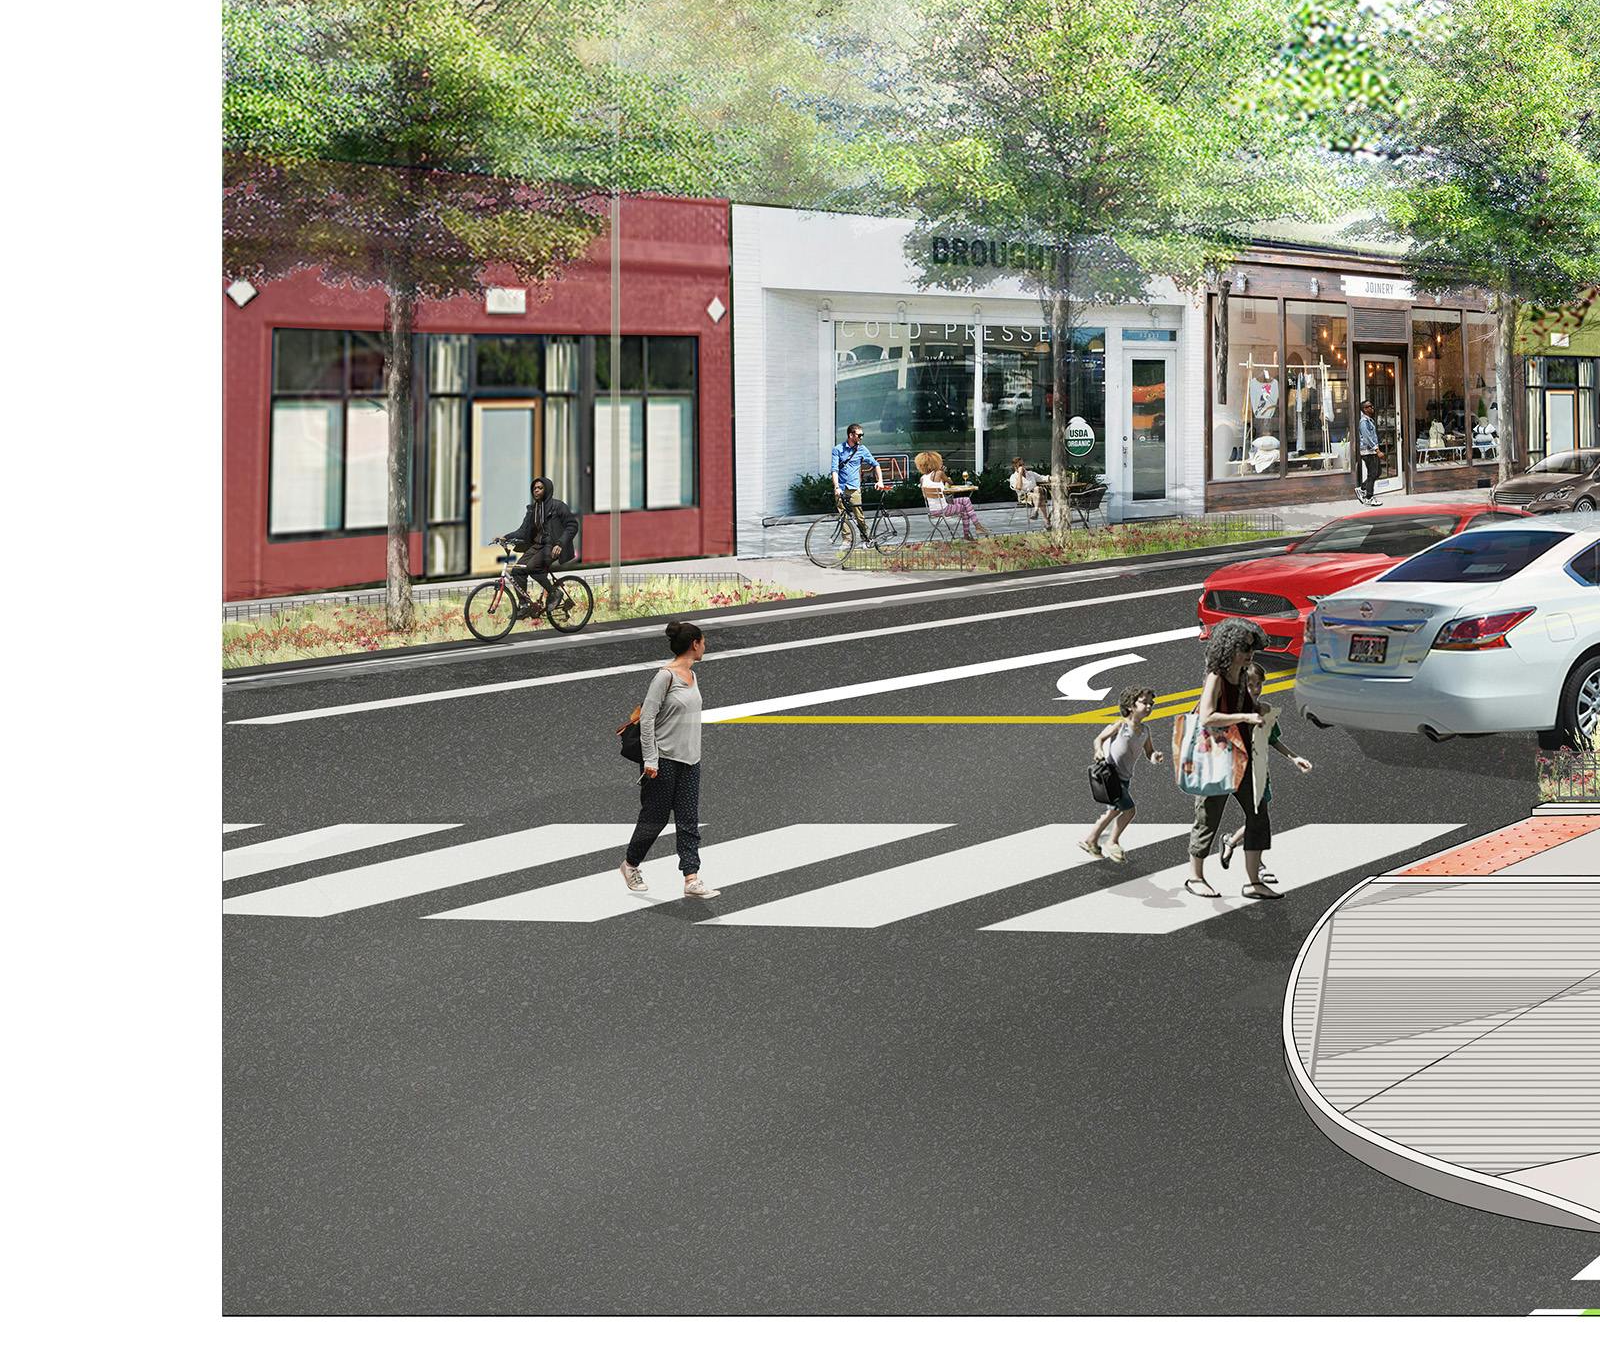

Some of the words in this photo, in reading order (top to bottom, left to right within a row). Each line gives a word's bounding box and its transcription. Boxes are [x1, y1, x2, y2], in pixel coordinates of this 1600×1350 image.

[932, 235, 1065, 272] DROUGHT
[1365, 281, 1394, 295] JOINERY
[1069, 429, 1089, 438] USDA
